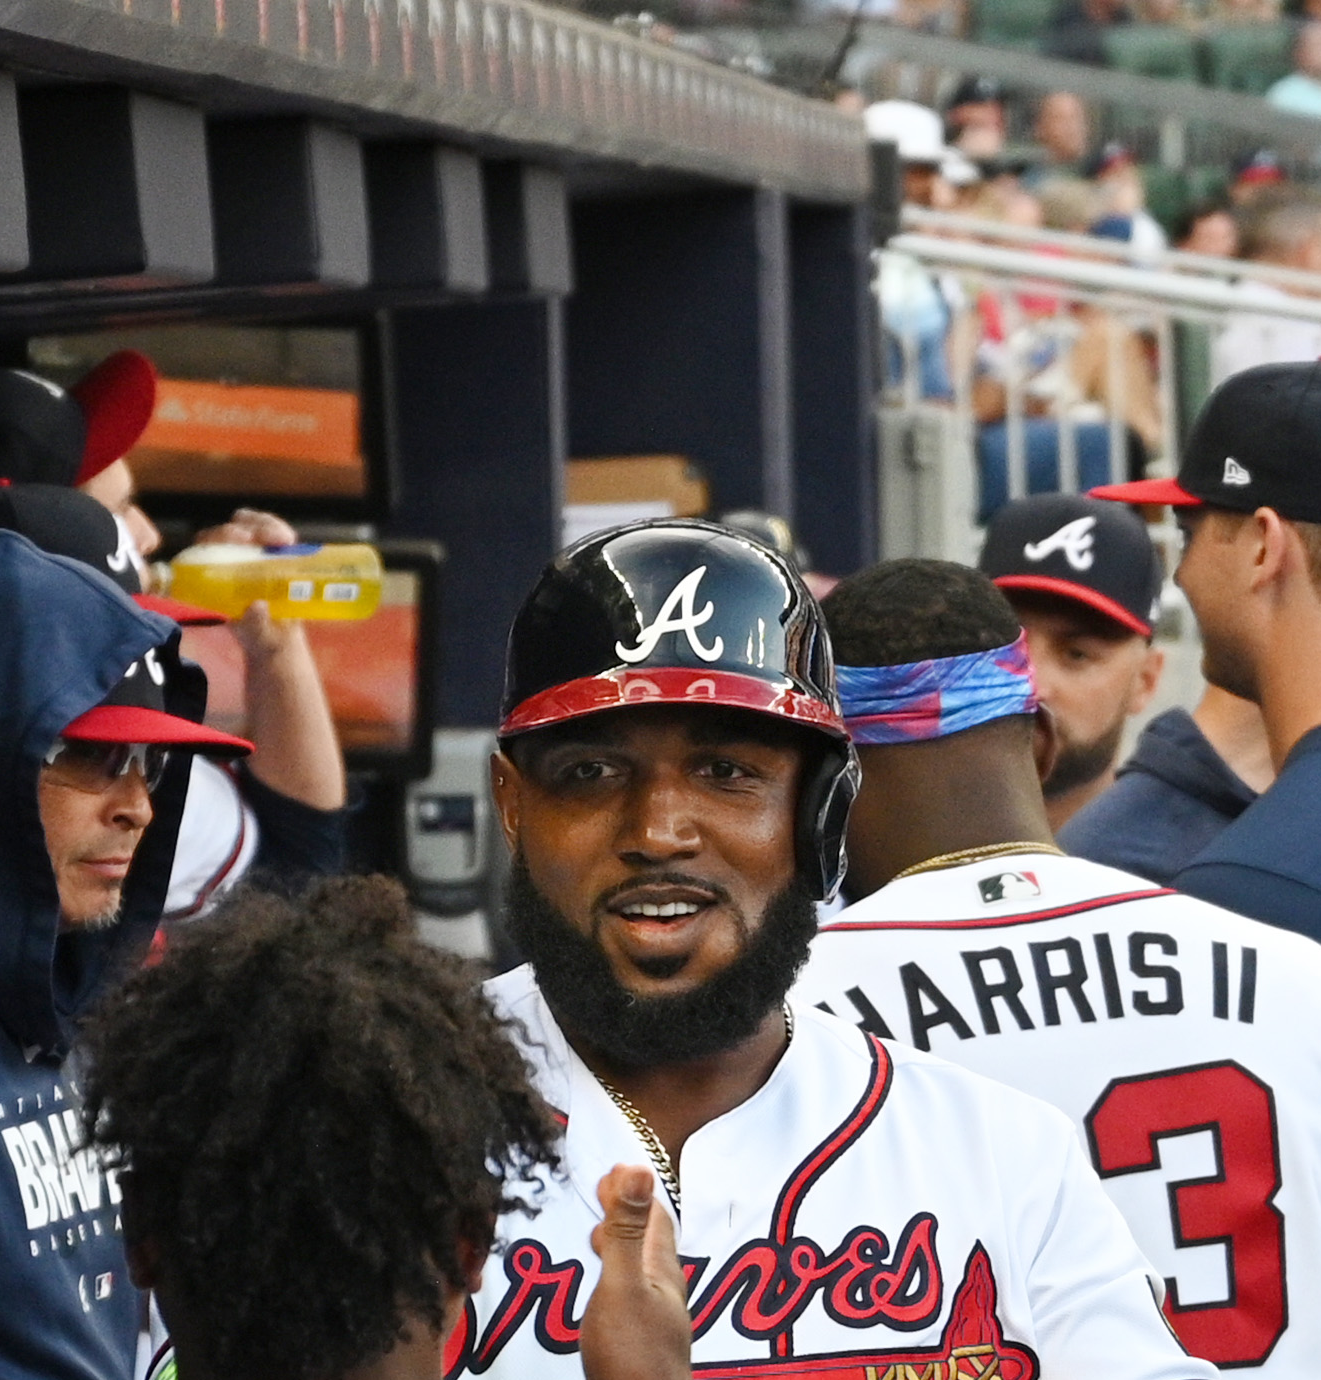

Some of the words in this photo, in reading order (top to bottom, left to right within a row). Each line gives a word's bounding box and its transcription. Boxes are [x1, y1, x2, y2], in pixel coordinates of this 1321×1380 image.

[1024, 516, 1096, 571] A
[615, 565, 723, 663] A
[30, 1213, 123, 1258] BASEBA
